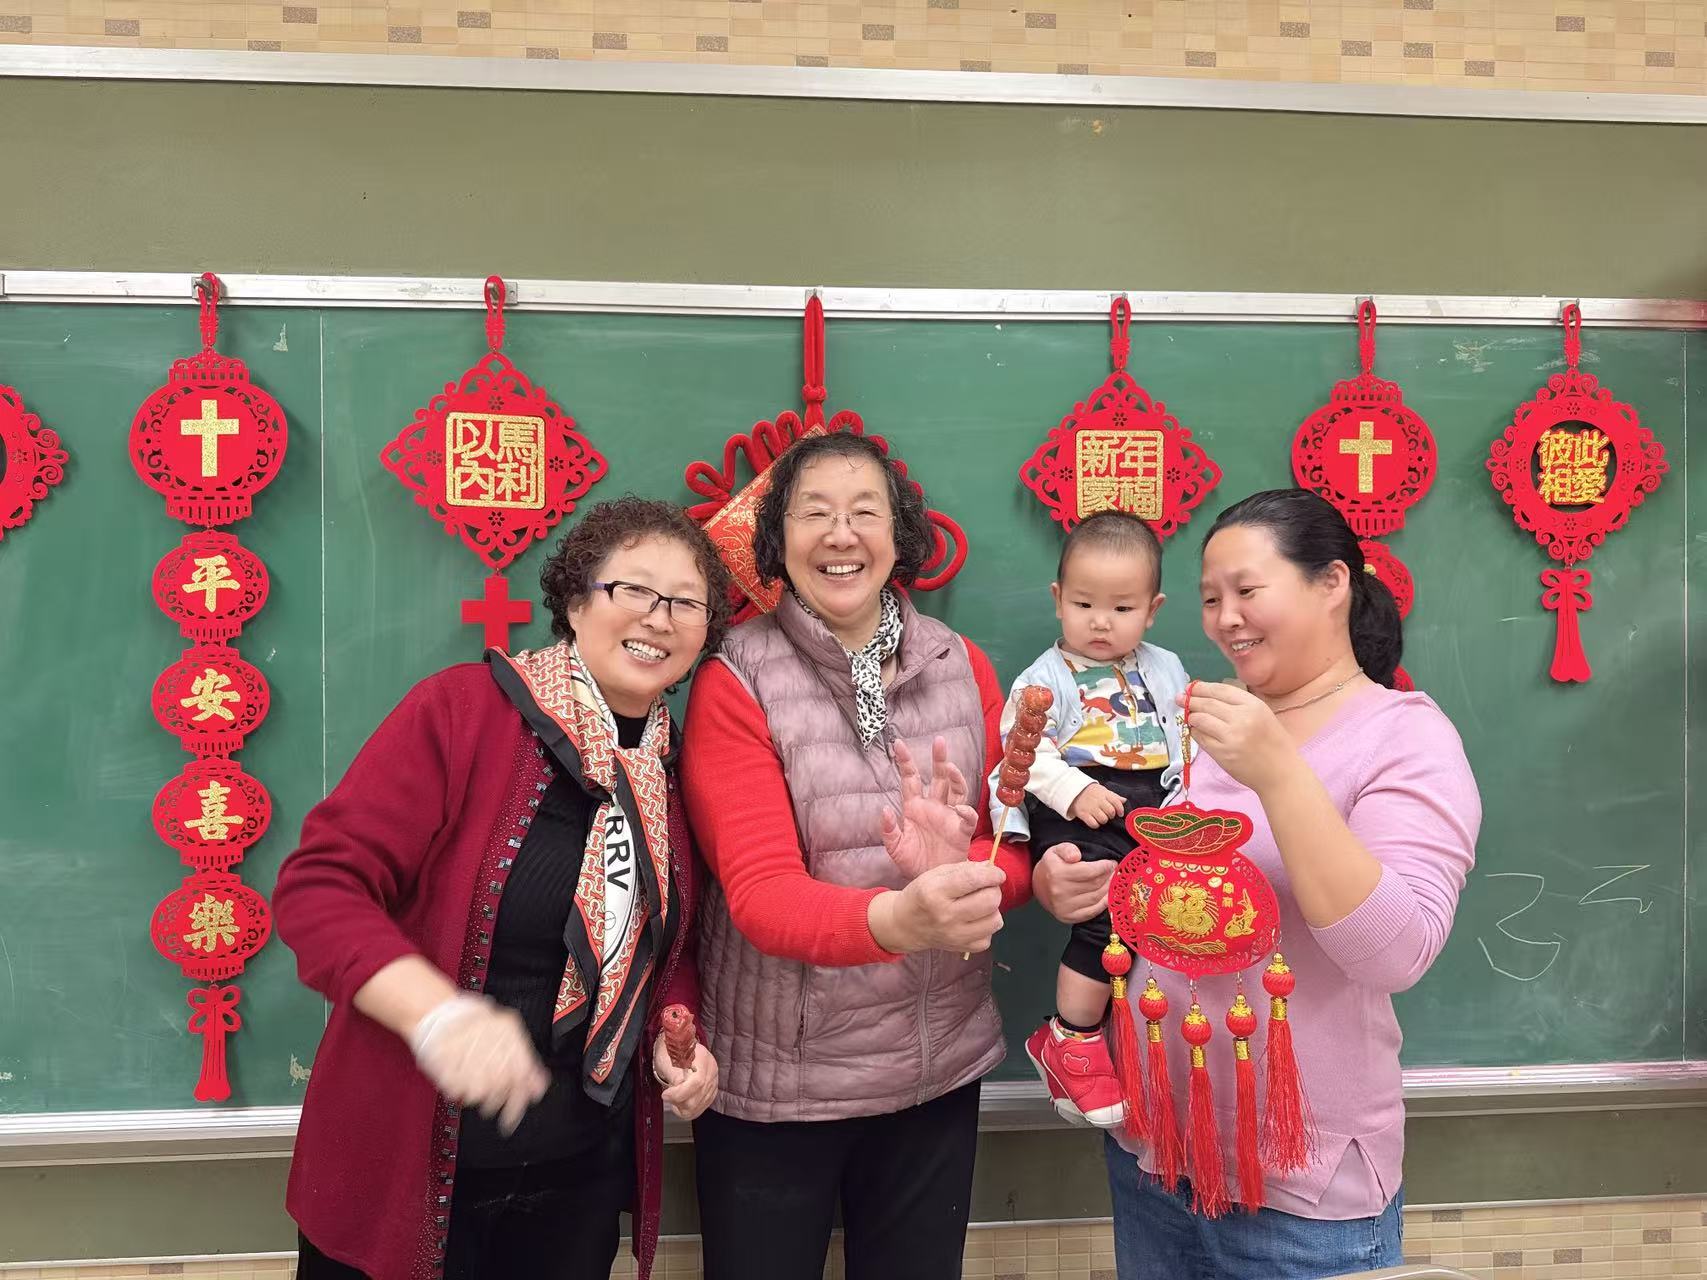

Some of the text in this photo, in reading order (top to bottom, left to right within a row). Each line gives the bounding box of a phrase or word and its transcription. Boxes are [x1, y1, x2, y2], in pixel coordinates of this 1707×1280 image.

[453, 419, 538, 463] 以馬
[1083, 437, 1157, 476] 新年
[1539, 430, 1610, 467] 彼此
[1083, 476, 1157, 513] 蒙福
[1538, 466, 1605, 503] 相愛
